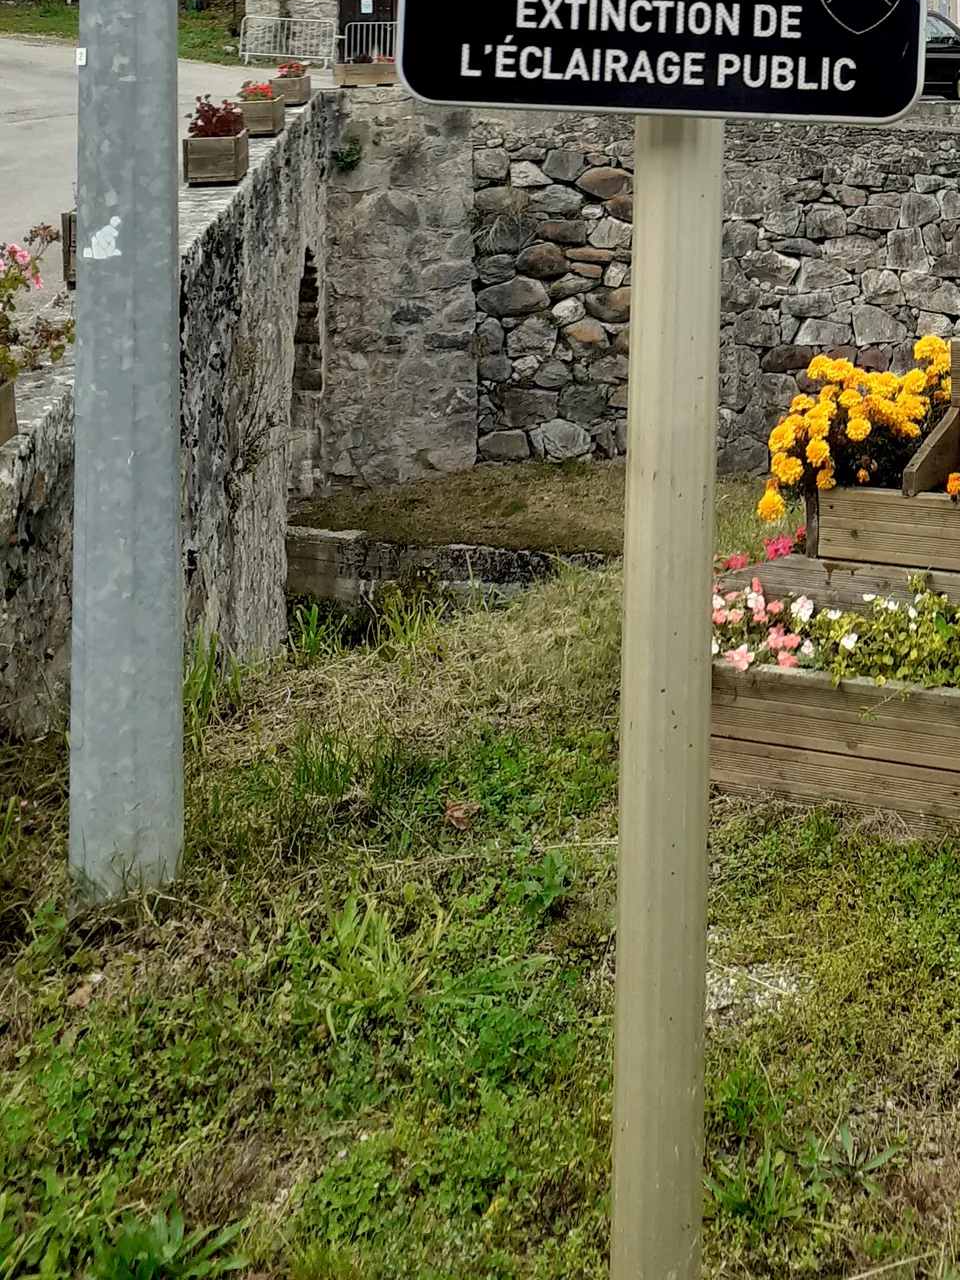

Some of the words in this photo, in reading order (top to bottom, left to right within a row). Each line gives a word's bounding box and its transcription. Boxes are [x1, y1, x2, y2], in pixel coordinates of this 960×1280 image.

[754, 4, 803, 39] DE
[460, 36, 706, 86] L'ÉCLAIRAGE
[717, 54, 857, 92] PUBLIC
